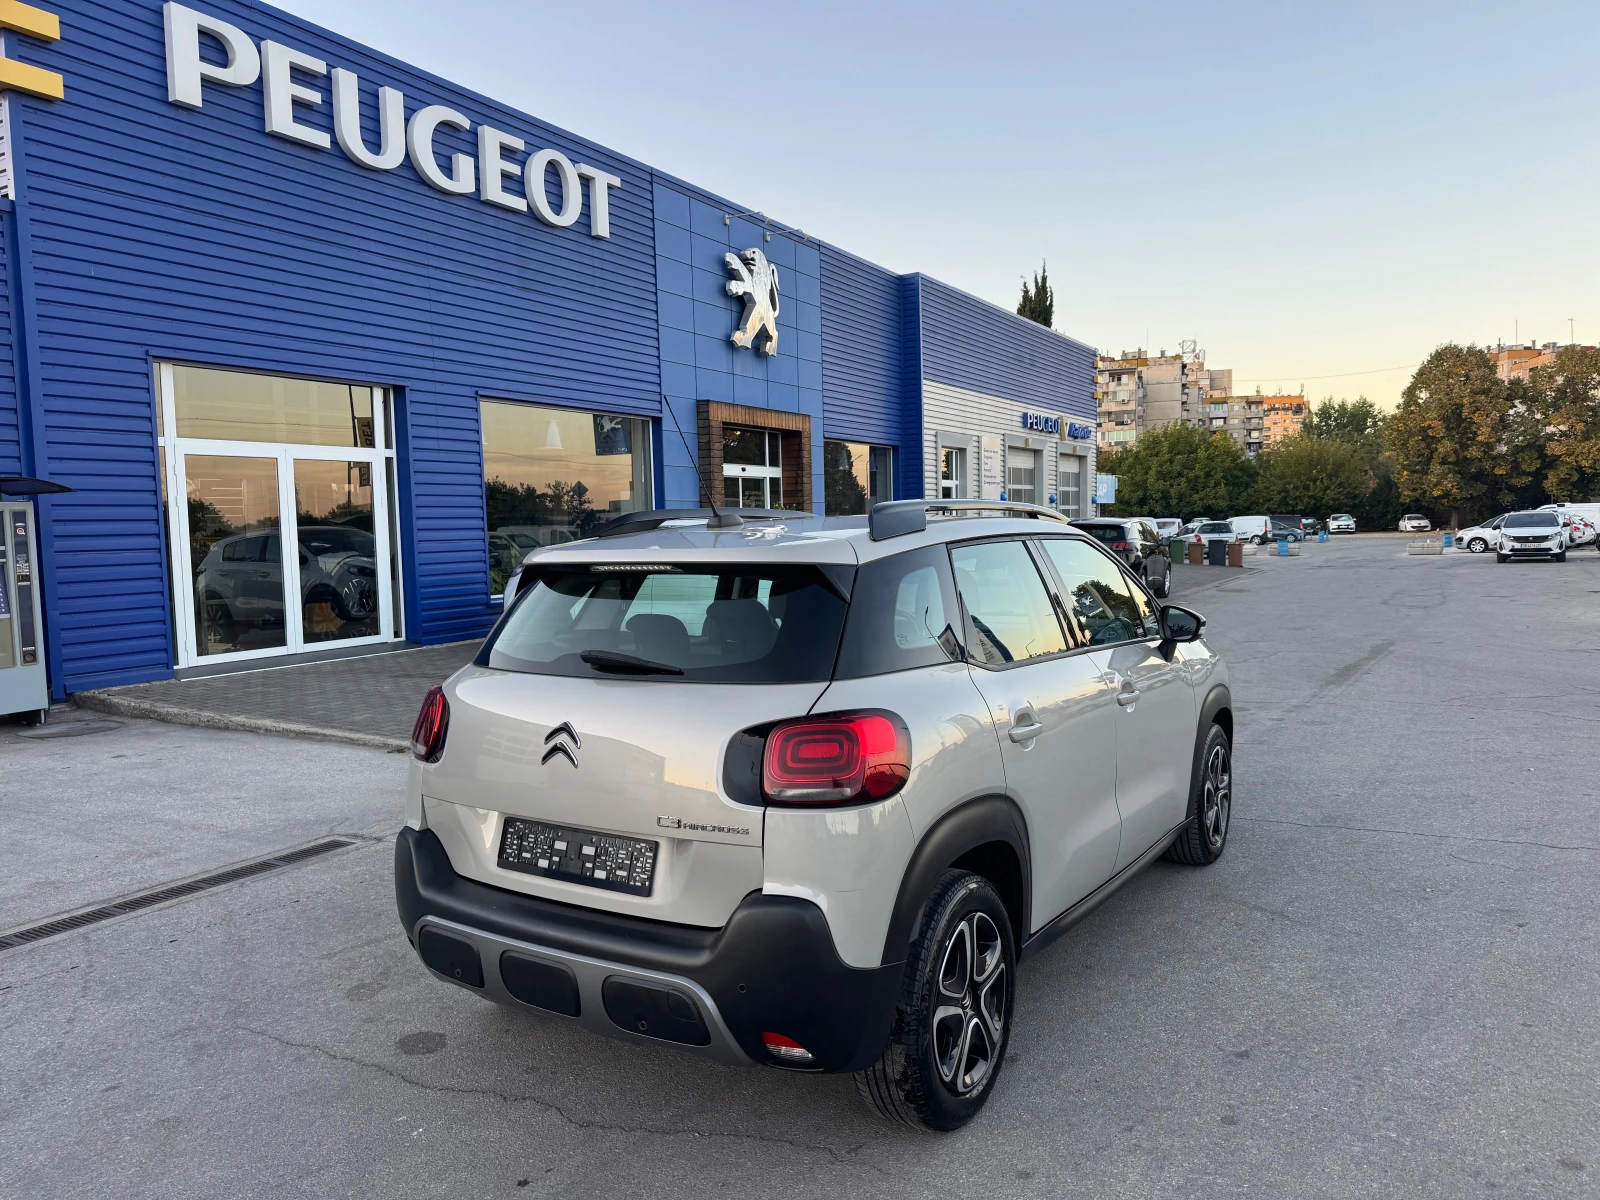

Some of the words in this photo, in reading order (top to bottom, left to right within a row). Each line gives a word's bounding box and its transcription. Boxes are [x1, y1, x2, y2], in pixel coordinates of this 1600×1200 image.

[163, 1, 621, 239] PEUGEOT
[1027, 413, 1062, 434] PEUGEOT
[657, 815, 681, 829] C3
[683, 822, 750, 835] AIRCROSS
